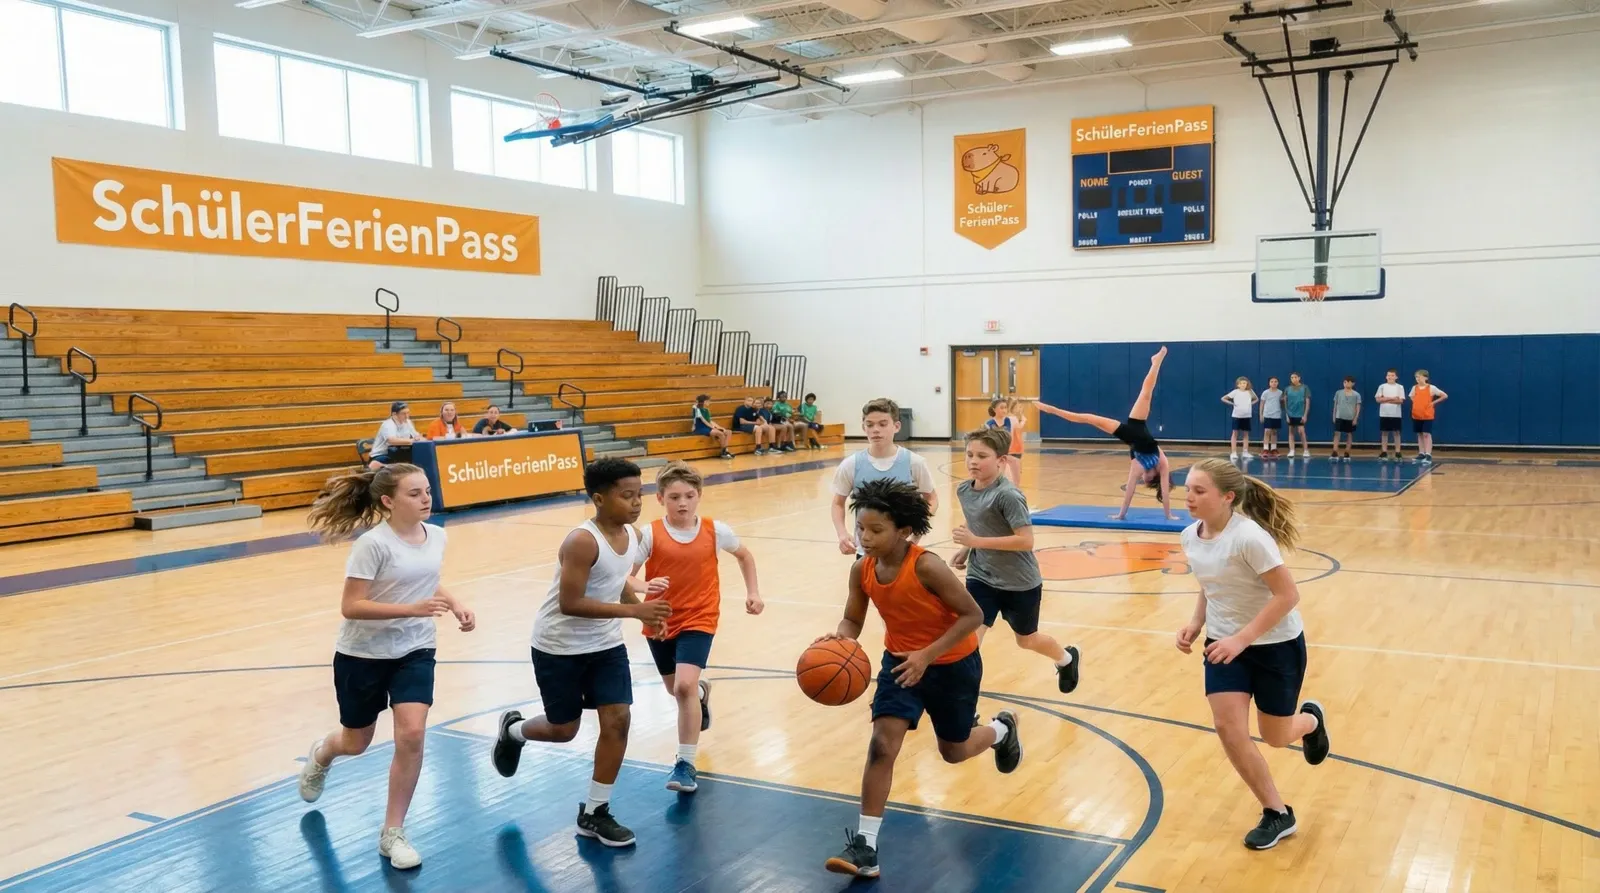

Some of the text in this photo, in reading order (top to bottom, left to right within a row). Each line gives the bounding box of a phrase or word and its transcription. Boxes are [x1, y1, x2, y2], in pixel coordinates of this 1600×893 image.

[1076, 119, 1208, 142] SchülerFerienPass
[1172, 169, 1203, 180] GUEST
[967, 201, 1015, 214] Schüler-
[92, 179, 518, 262] SchülerFerienPass
[959, 215, 1020, 228] FerienPass
[448, 453, 578, 483] SchülerFerienPass
